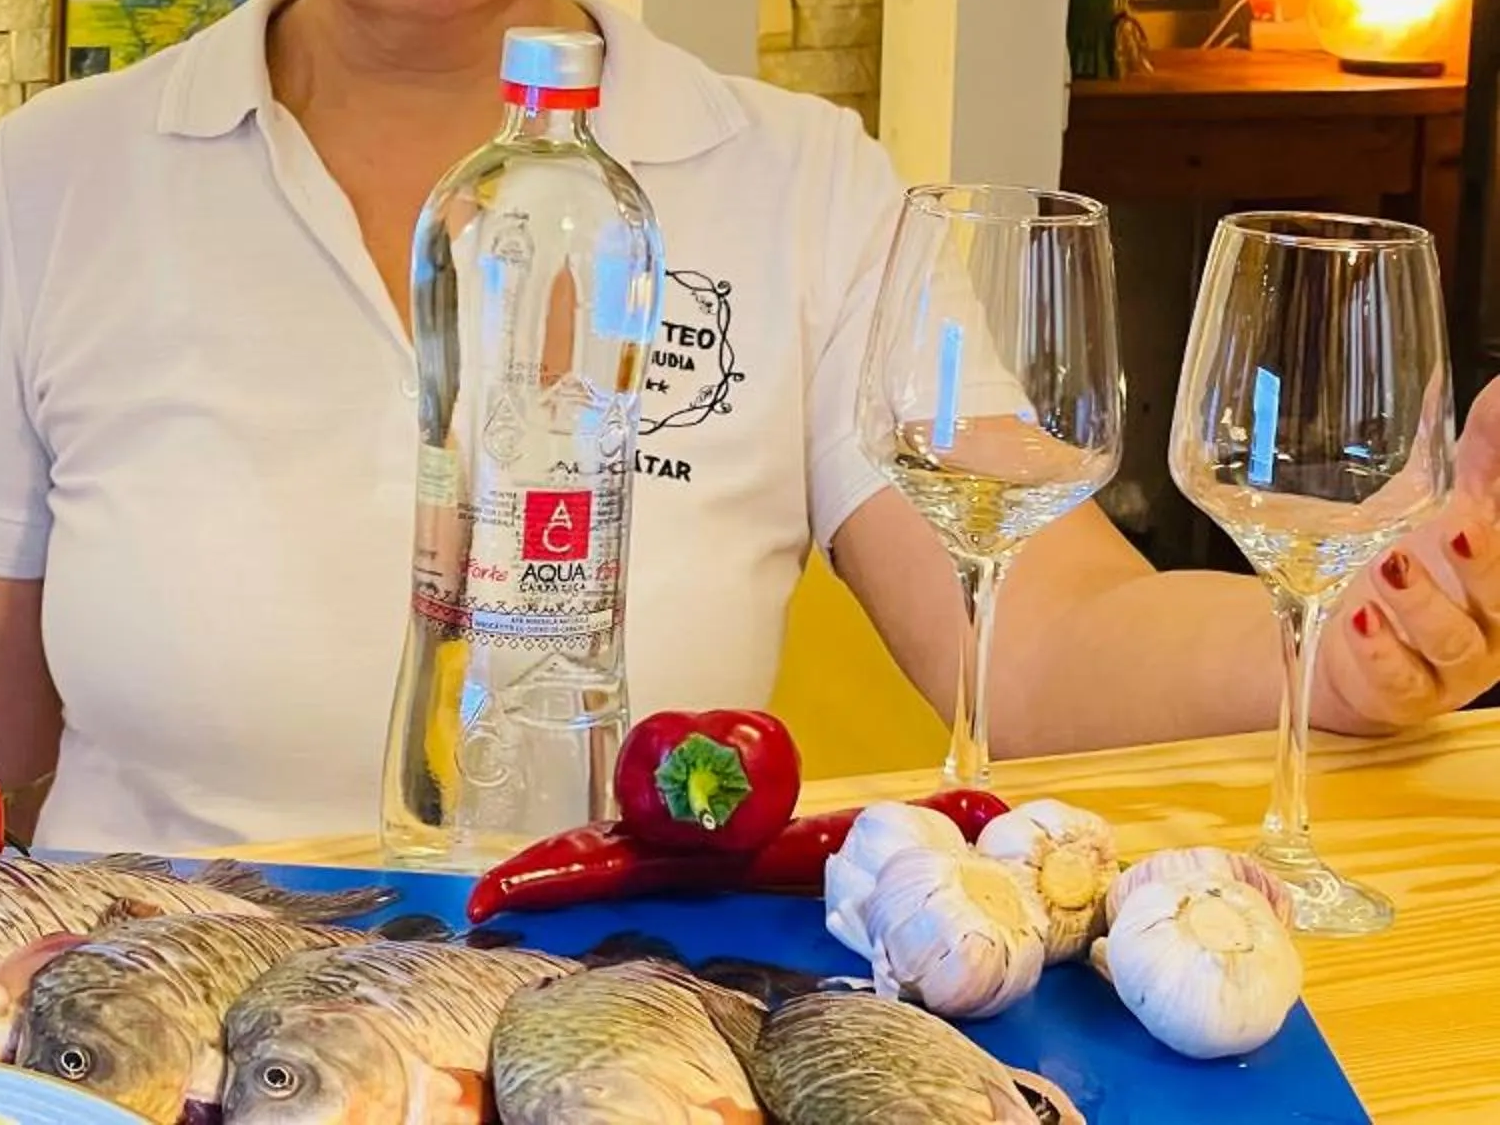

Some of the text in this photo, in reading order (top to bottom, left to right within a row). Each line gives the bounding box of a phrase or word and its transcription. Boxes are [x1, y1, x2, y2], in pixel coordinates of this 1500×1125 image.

[661, 321, 715, 350] TEO
[651, 349, 695, 371] UDIA
[521, 564, 587, 583] AQUA
